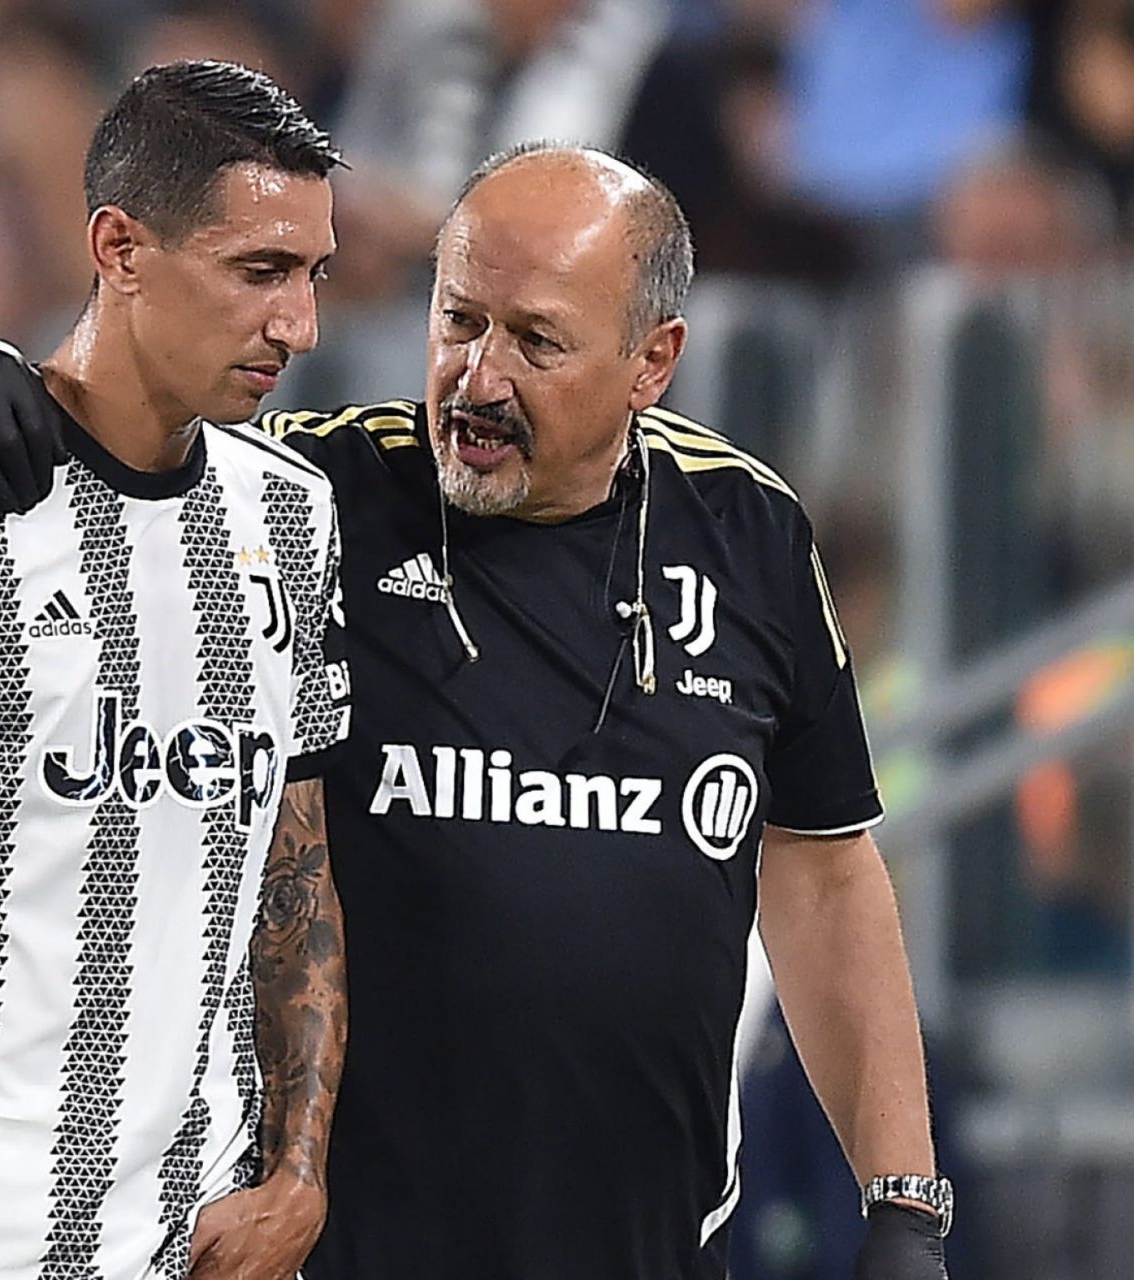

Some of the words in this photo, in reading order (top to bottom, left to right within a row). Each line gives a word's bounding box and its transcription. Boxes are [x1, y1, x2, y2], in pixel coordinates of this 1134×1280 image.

[28, 619, 93, 640] adidas
[676, 668, 733, 705] Jeep
[42, 694, 279, 828] Jeep
[369, 744, 663, 834] Allianz
